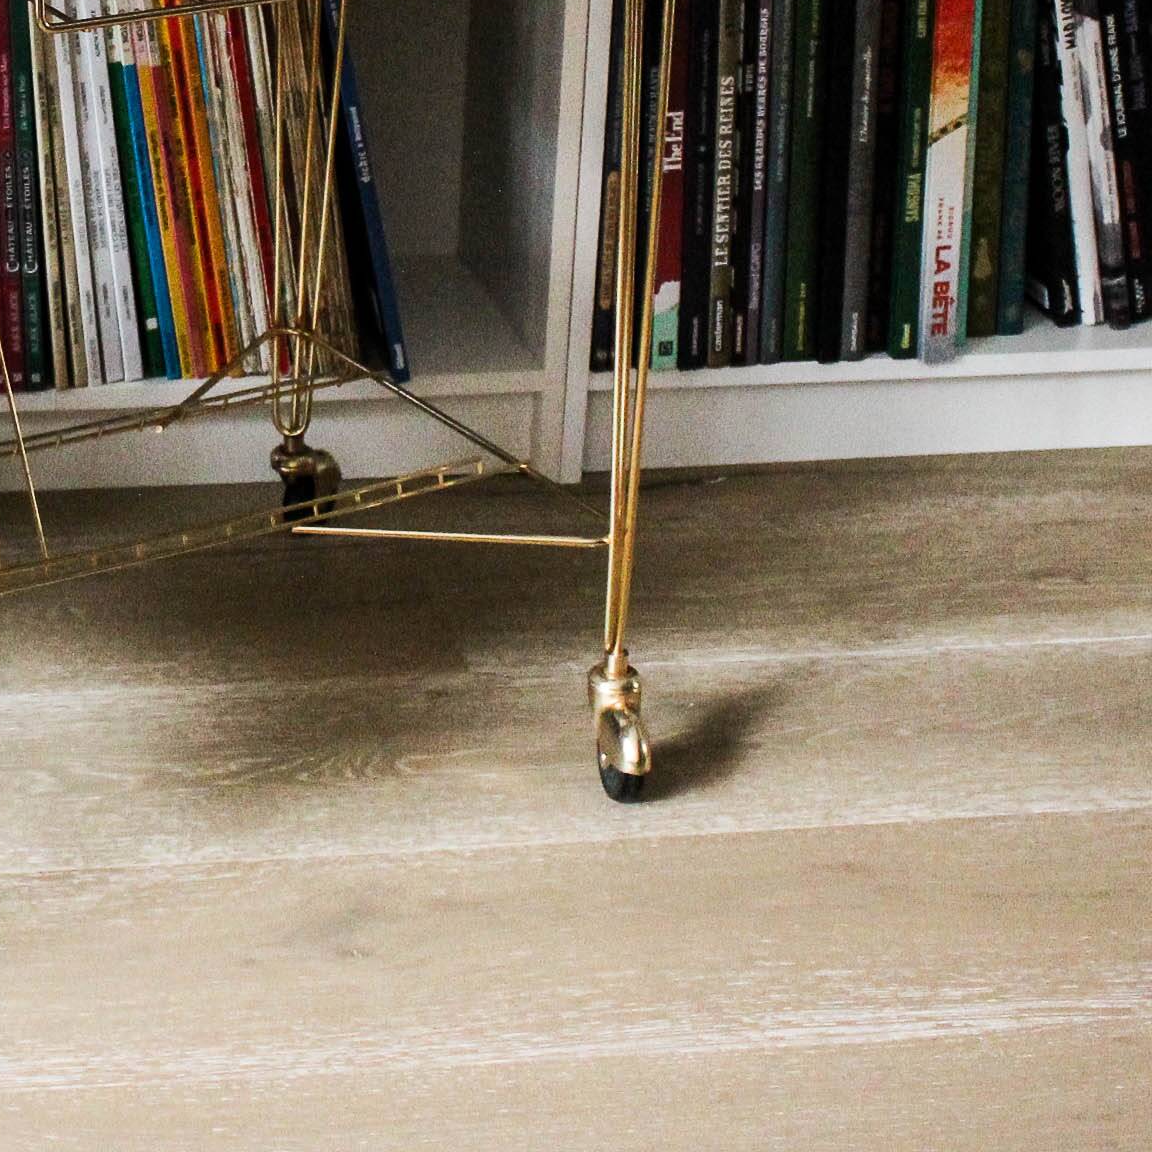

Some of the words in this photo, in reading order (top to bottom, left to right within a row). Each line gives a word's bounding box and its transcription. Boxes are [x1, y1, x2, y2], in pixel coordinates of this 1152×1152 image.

[1063, 22, 1077, 50] MAD
[1106, 14, 1119, 46] FRANK
[1108, 47, 1121, 81] D'ANNE
[719, 75, 735, 135] REINES
[1111, 82, 1126, 127] JOURNAL
[664, 110, 684, 141] End
[753, 172, 763, 191] LES
[758, 58, 768, 74] DE
[1116, 128, 1128, 138] LE
[661, 143, 682, 173] The
[718, 141, 733, 170] DES
[715, 175, 732, 244] SENTIER
[714, 244, 728, 267] LE
[934, 245, 952, 274] LA
[931, 280, 956, 337] BÊTE
